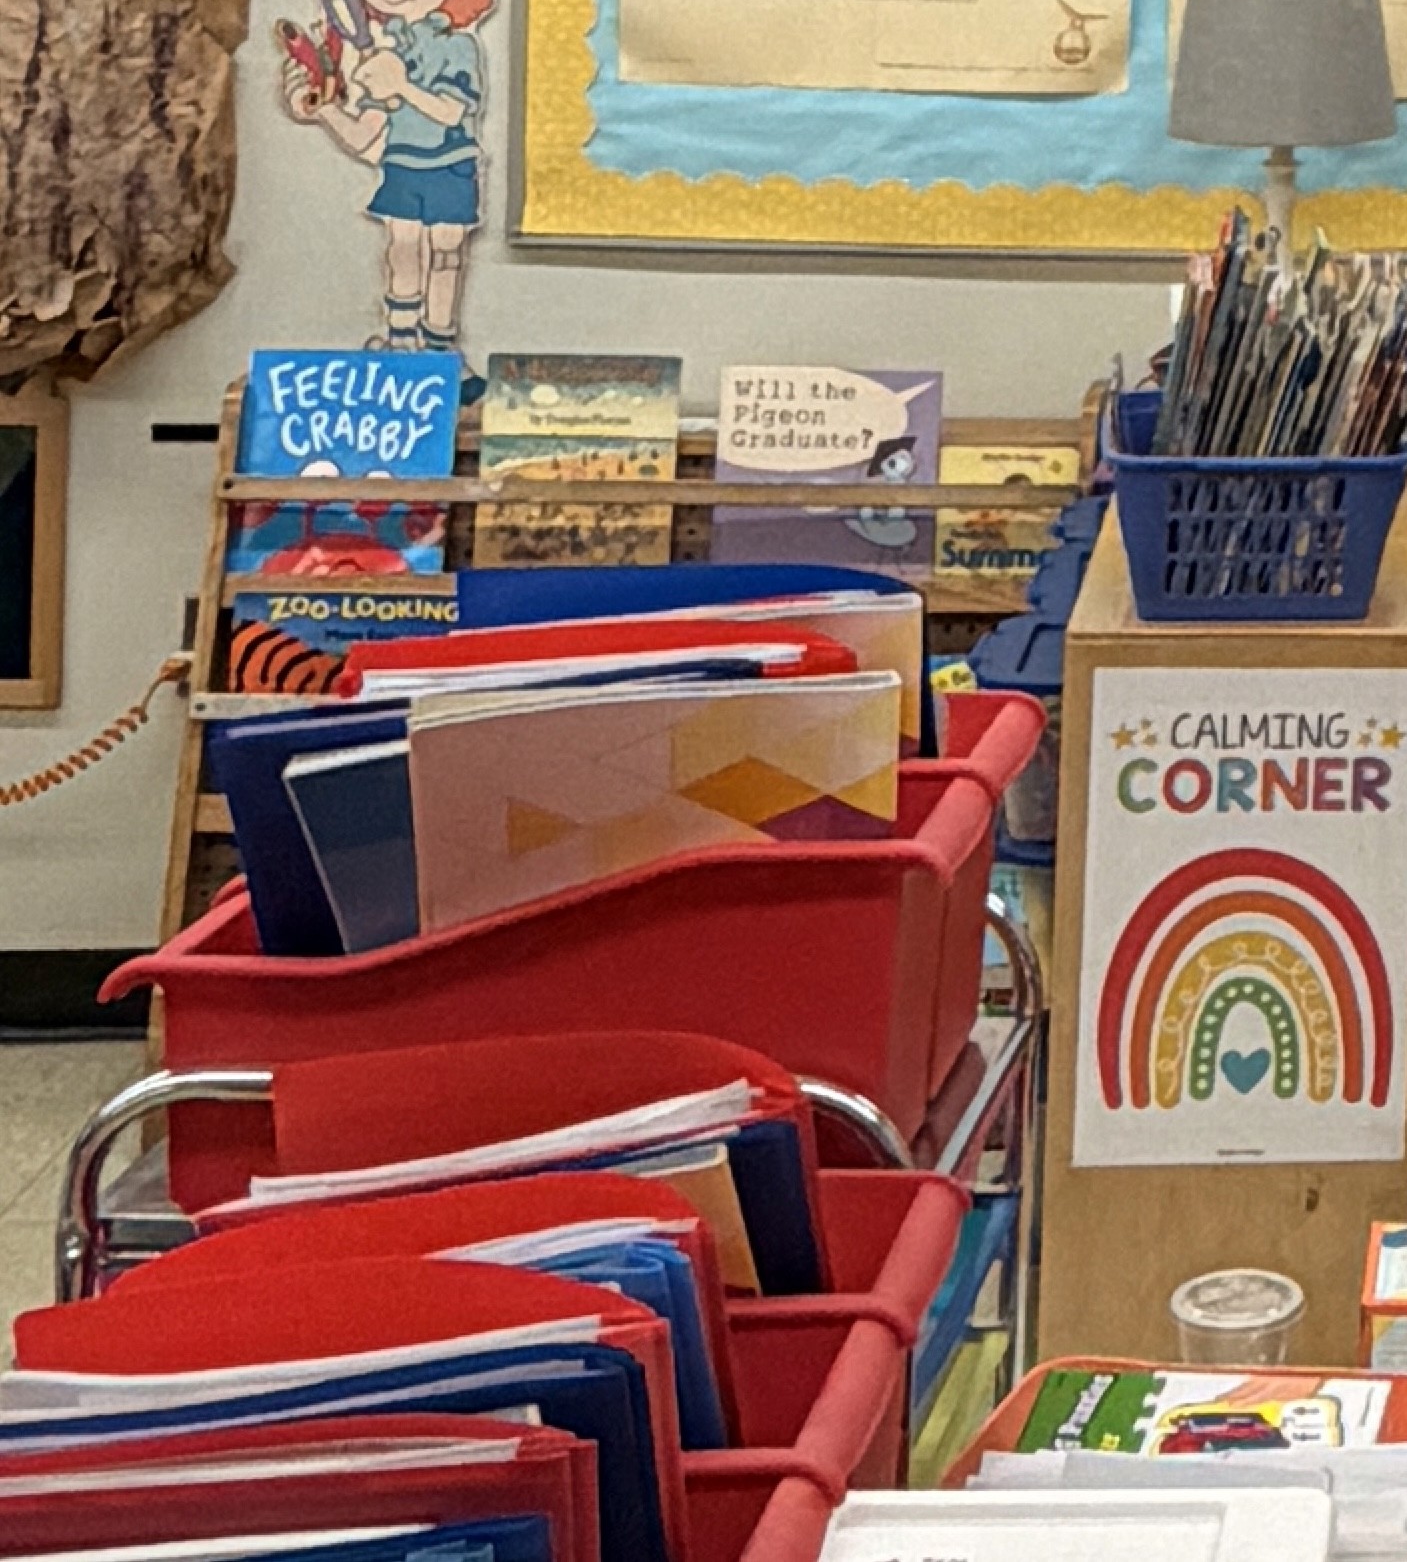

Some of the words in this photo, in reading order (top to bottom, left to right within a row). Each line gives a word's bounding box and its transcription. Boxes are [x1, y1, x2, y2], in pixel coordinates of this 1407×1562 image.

[268, 359, 446, 423] FEELING
[734, 378, 797, 400] Will
[809, 379, 856, 401] the
[732, 403, 826, 428] Pigeon
[280, 409, 434, 462] CRABBY
[730, 427, 874, 452] Graduate?
[267, 596, 460, 623] ZOO-LOOKING
[1170, 711, 1350, 751] CALMING
[1116, 755, 1393, 815] CORNER
